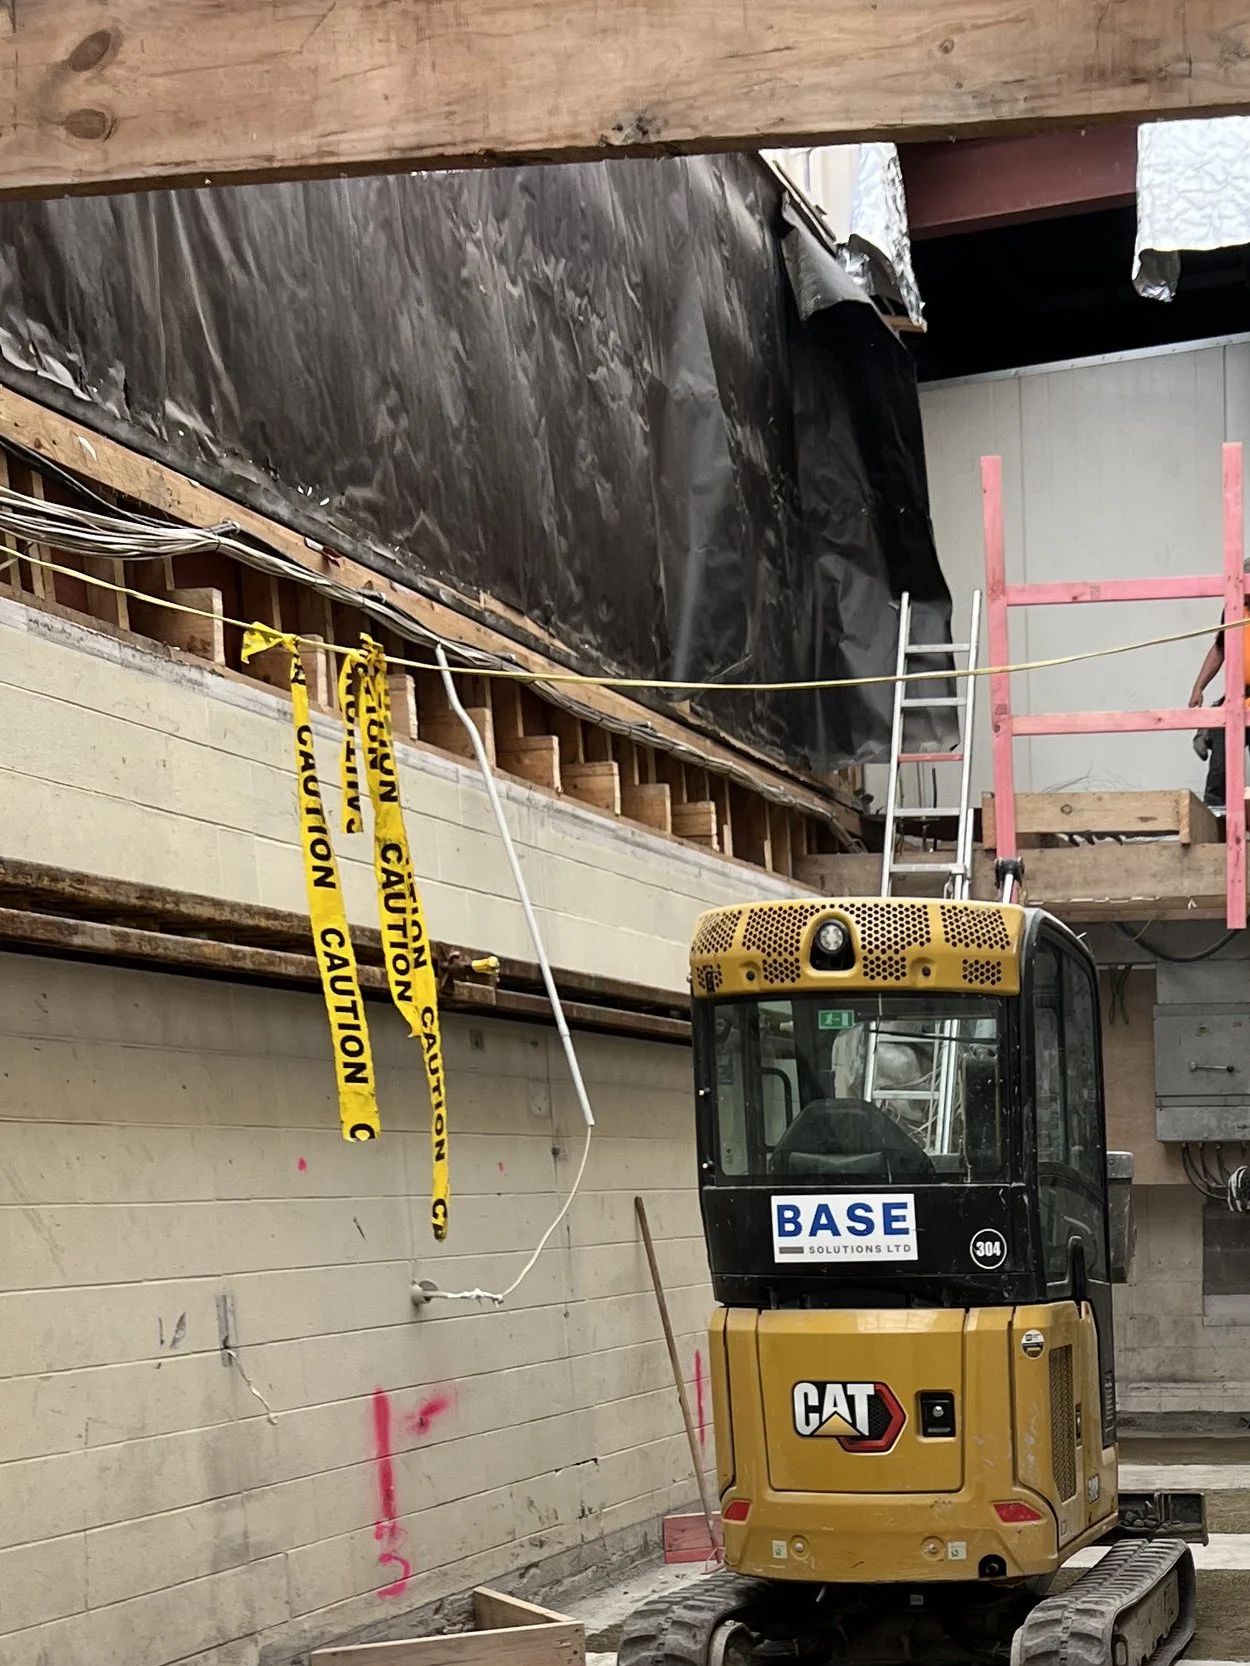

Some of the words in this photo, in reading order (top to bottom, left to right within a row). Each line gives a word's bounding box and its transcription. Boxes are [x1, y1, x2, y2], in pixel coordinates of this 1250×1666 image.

[296, 725, 337, 890] CAUTION
[320, 927, 370, 1086] CAUTION
[380, 843, 413, 1002] CAUTION
[421, 1006, 446, 1162] CAUTION
[776, 1202, 911, 1238] BASE
[809, 1244, 882, 1255] SOLUTIONS
[887, 1243, 911, 1254] LTD
[975, 1241, 1002, 1257] 304
[793, 1382, 875, 1436] CAT
